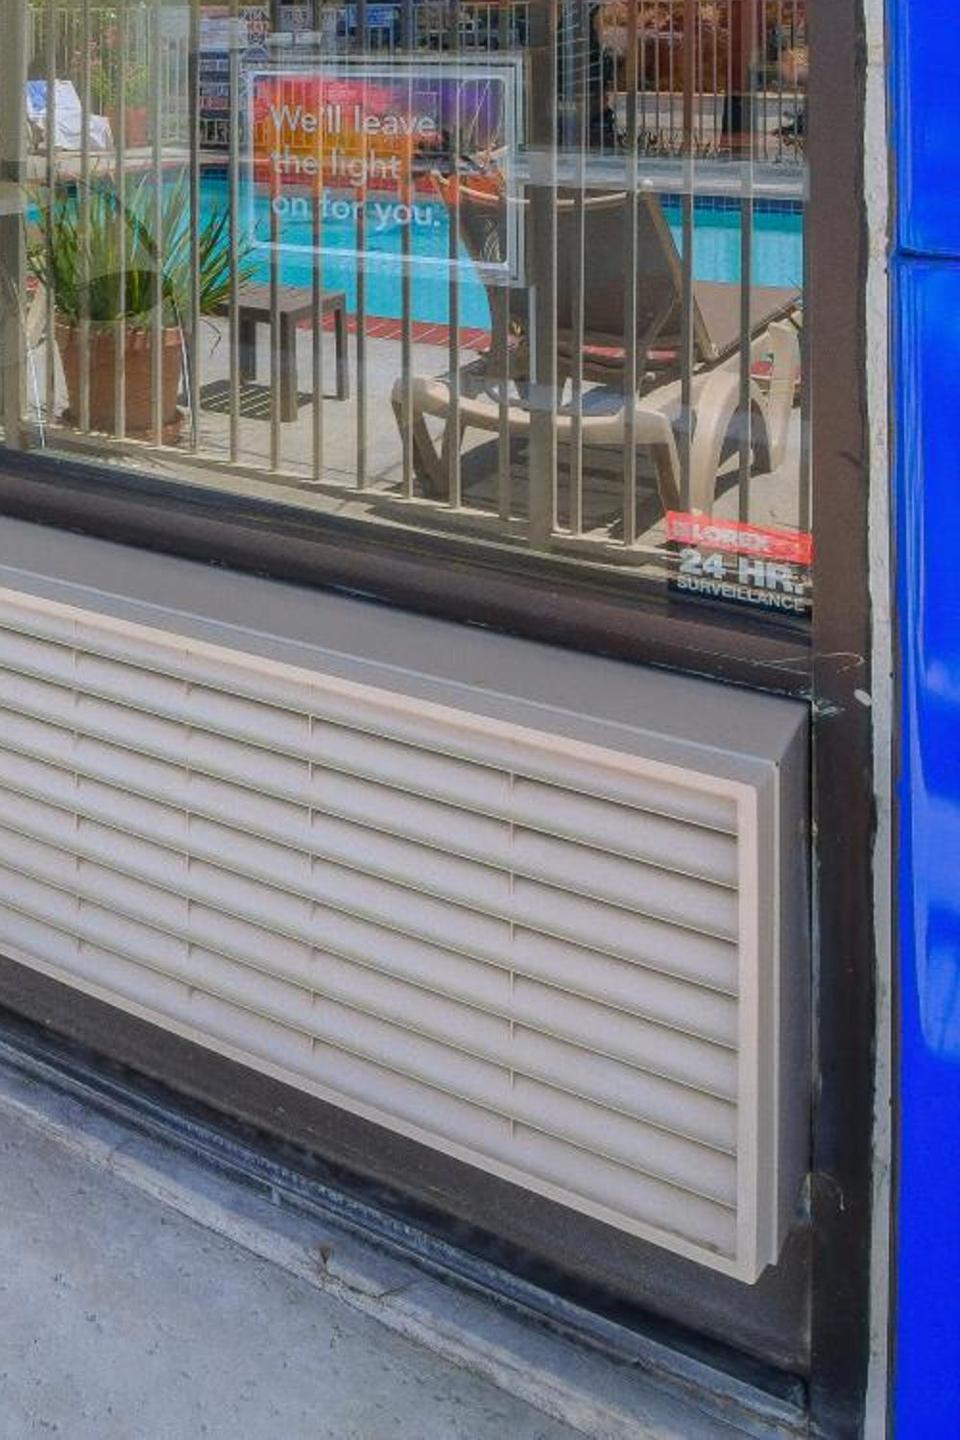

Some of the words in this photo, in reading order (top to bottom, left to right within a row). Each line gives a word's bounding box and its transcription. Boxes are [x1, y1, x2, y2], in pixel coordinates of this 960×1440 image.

[270, 104, 340, 134] We'll
[355, 105, 436, 136] leave
[270, 150, 320, 176] the
[331, 150, 402, 187] light
[271, 195, 308, 217] on
[319, 189, 364, 220] for
[374, 202, 441, 231] you.
[678, 547, 728, 580] 24
[677, 575, 806, 612] SURVEILLANCE
